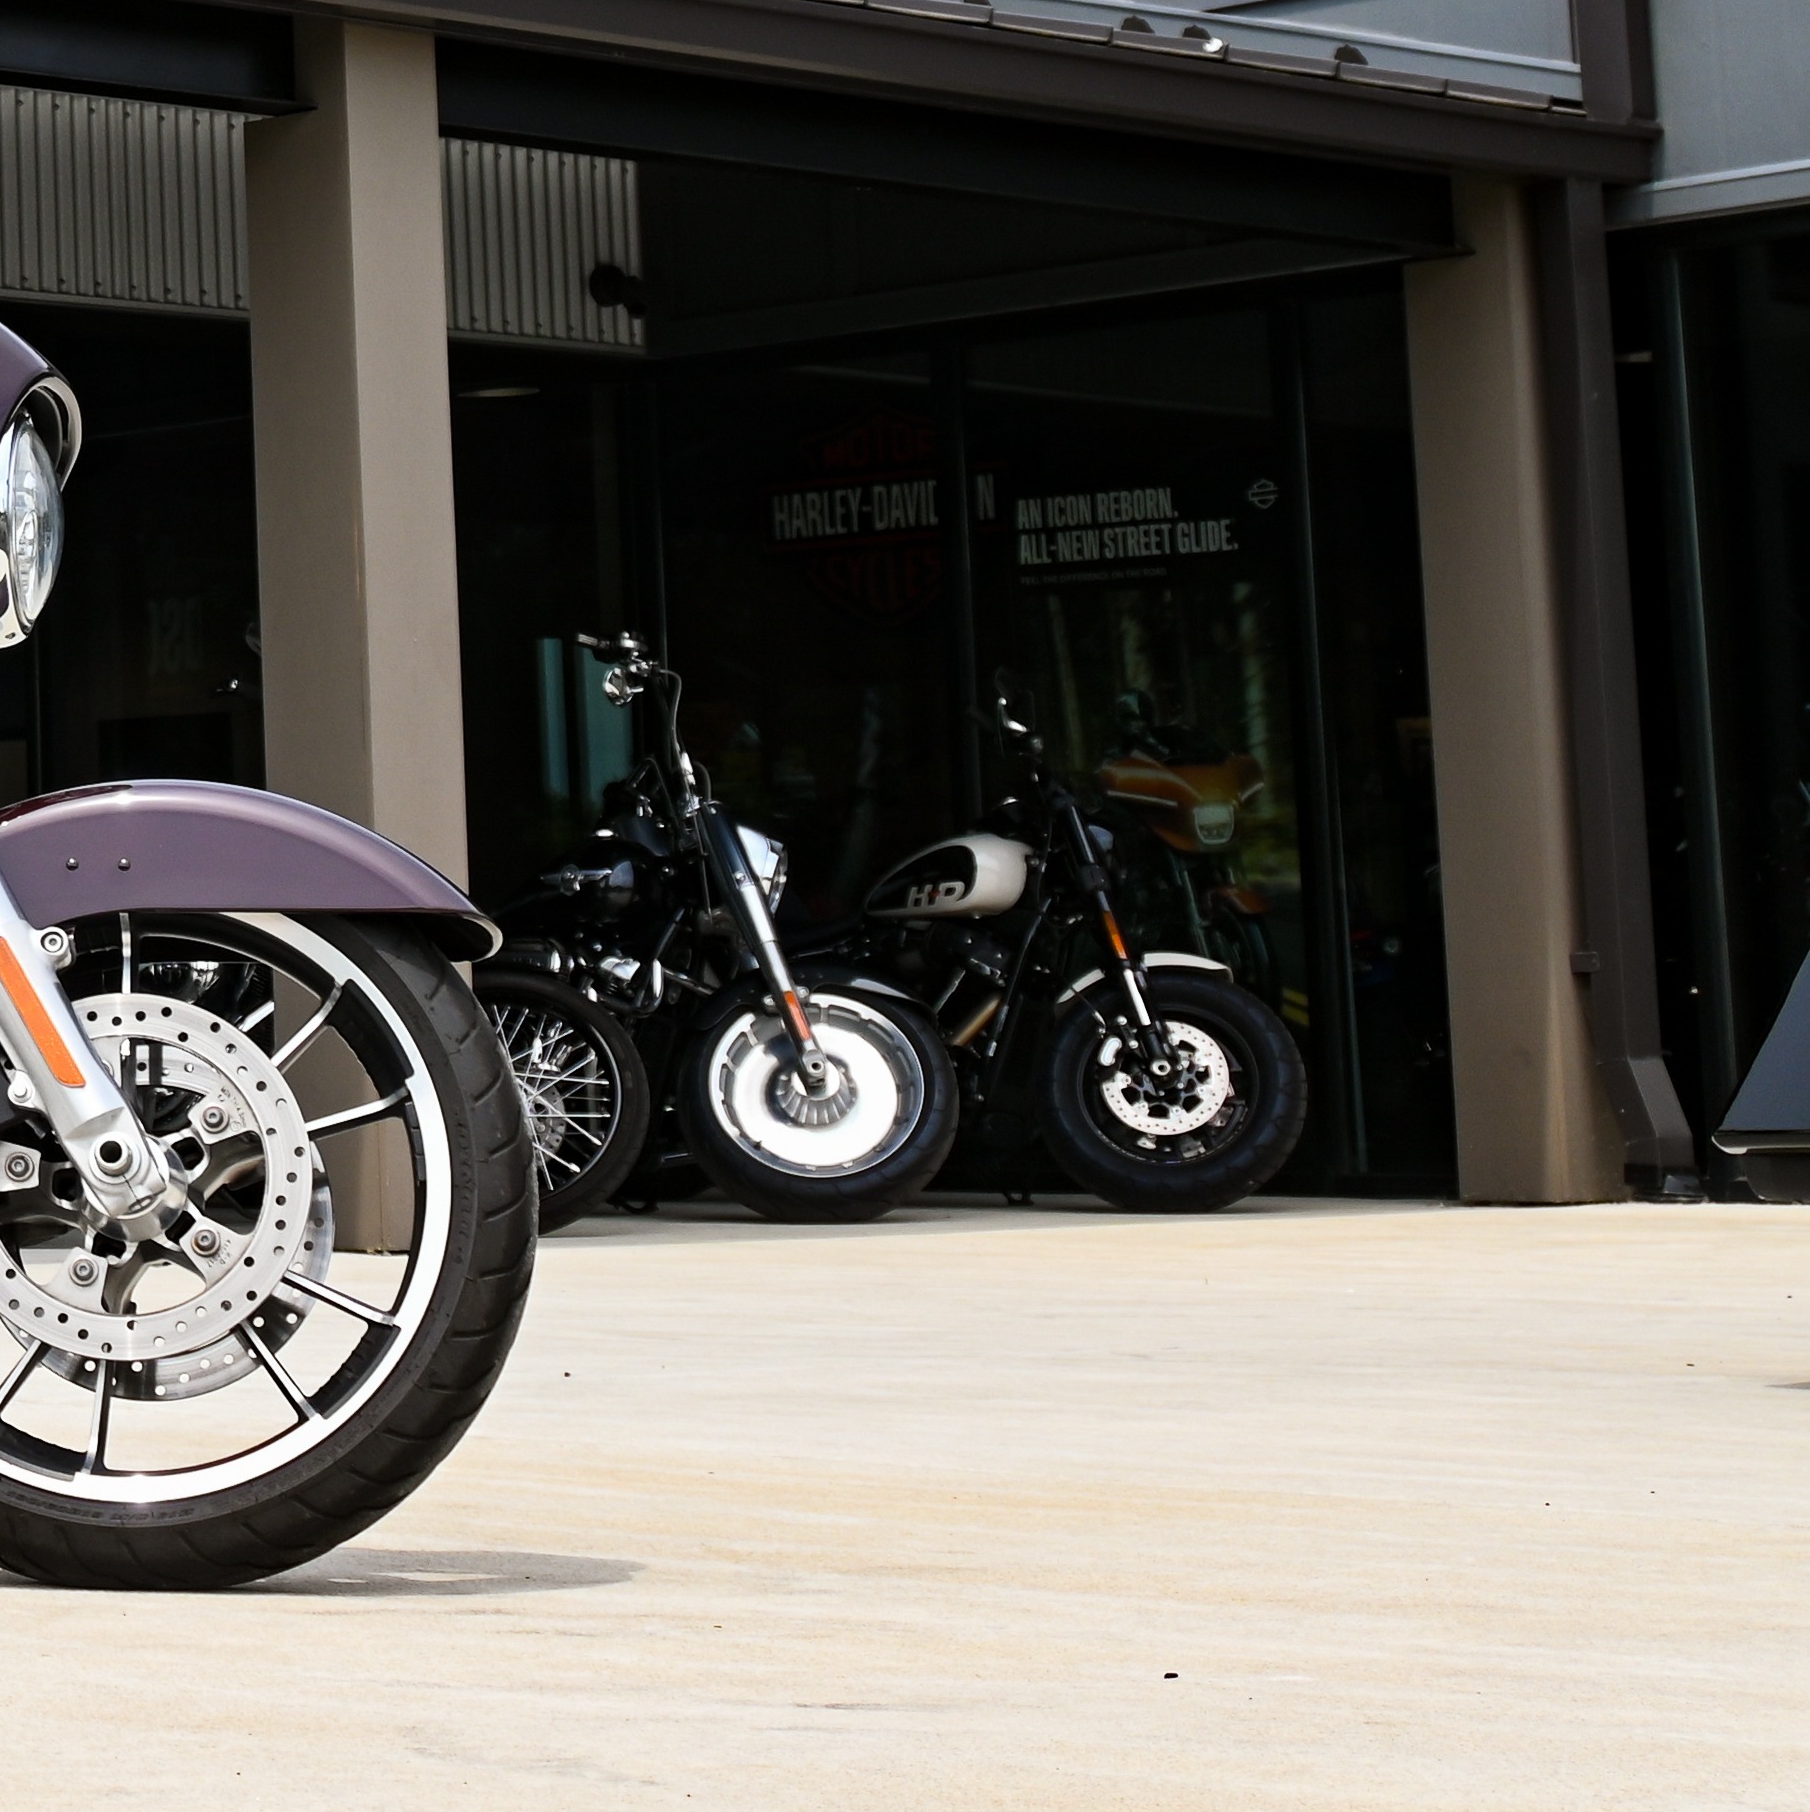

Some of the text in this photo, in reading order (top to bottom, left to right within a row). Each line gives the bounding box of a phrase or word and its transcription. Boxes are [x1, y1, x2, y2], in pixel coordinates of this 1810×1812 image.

[771, 473, 997, 542] HARLEY-DAVIDN
[1016, 487, 1180, 530] AN ICON REBORN.
[1019, 518, 1239, 565] ALL-NEW STREET GLIDE.
